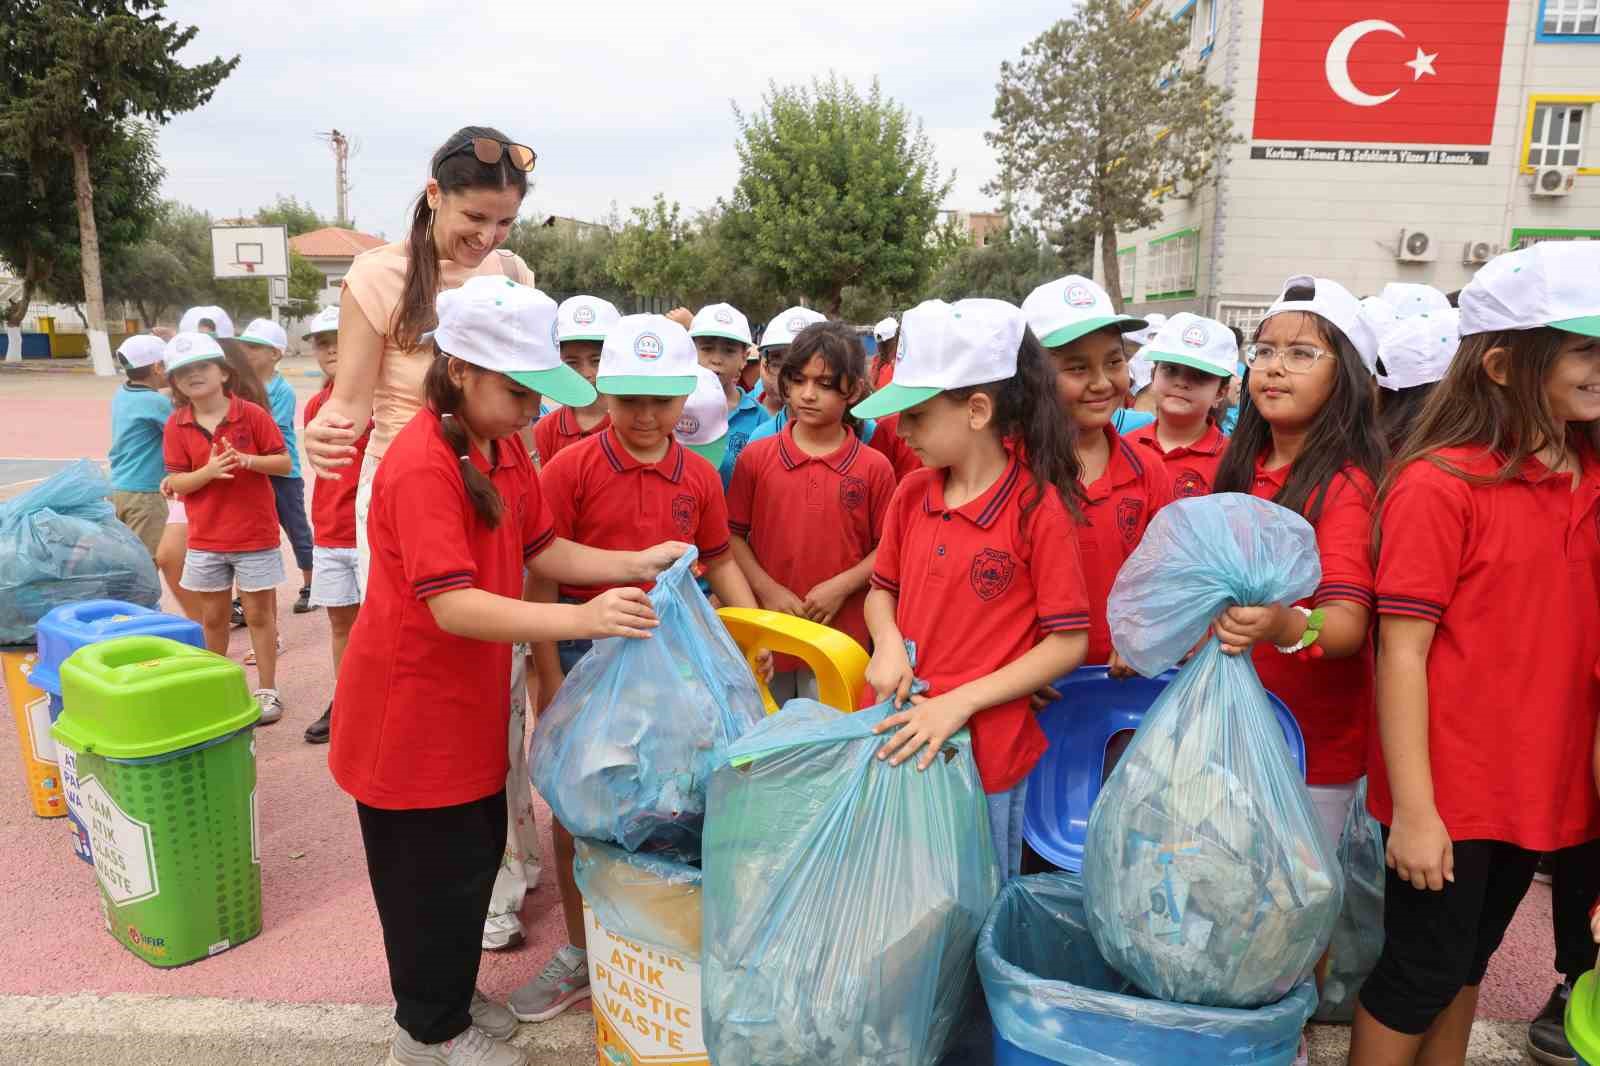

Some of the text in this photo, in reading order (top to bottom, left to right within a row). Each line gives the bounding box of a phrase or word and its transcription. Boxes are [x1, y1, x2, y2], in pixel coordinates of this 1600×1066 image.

[87, 794, 112, 821] CAM
[92, 816, 117, 844] ATIK
[97, 856, 133, 894] WASTE
[610, 949, 665, 990] ATIK
[595, 963, 691, 1028] PLASTIC
[603, 992, 684, 1052] WASTE
